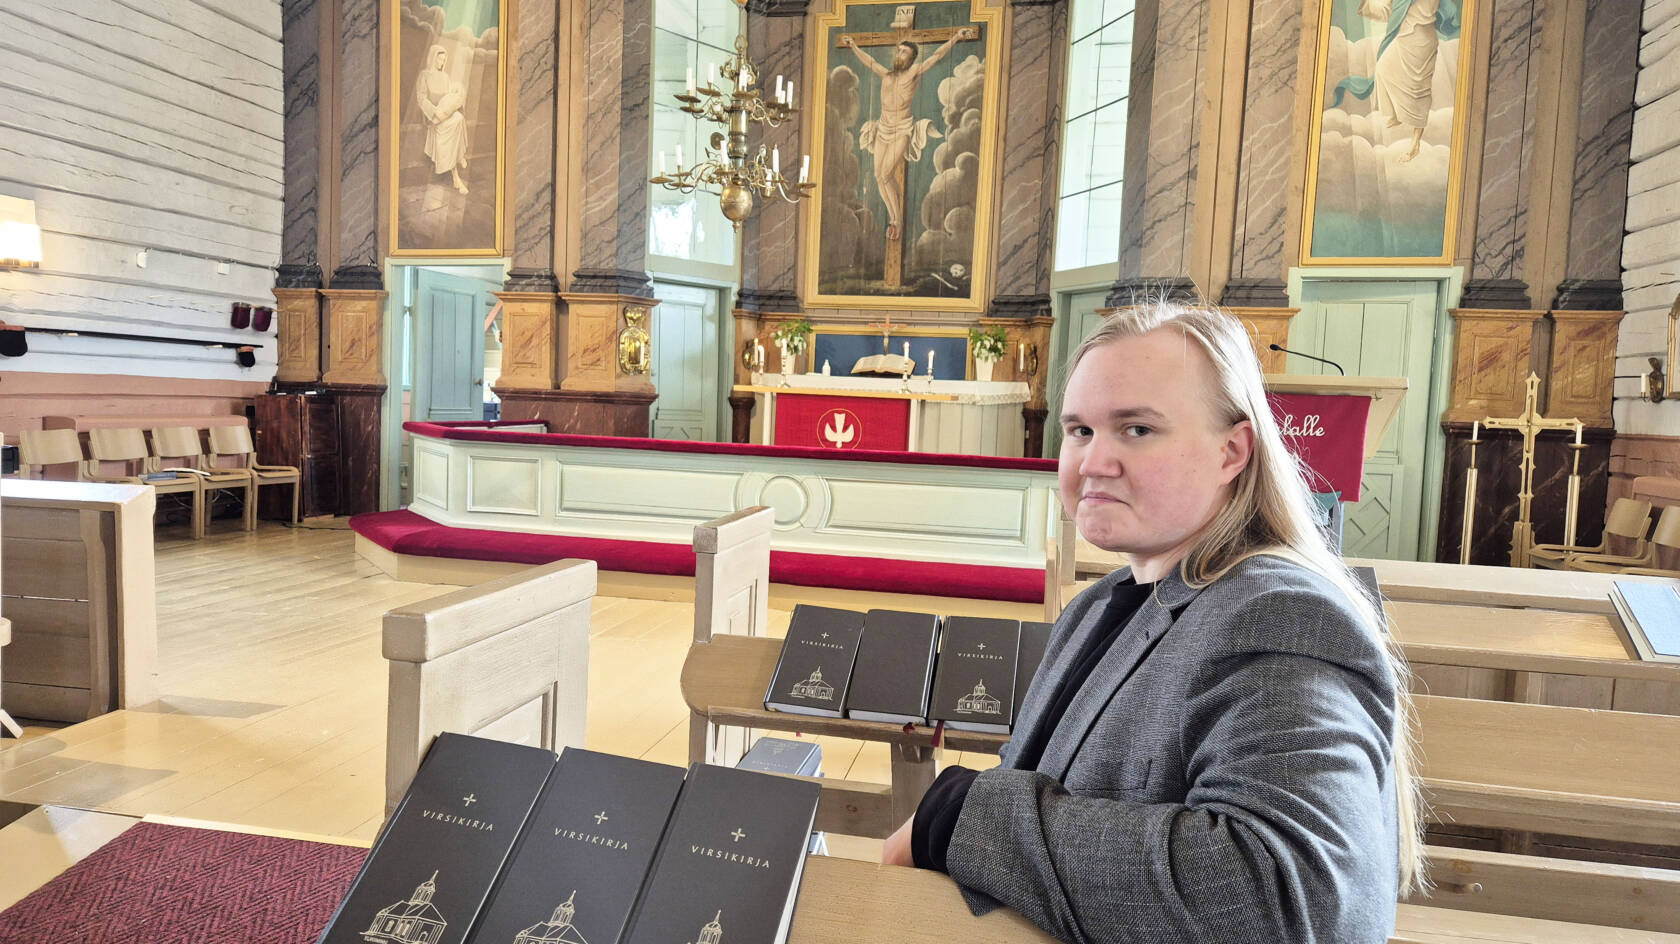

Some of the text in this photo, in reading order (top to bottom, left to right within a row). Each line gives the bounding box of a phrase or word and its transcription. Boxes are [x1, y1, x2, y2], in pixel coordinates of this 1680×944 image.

[1280, 414, 1325, 437] lalle
[801, 640, 844, 649] VIRSIKIRJA
[957, 652, 1003, 660] VIRSIKIRJA
[423, 810, 494, 832] VIRSIKIRJA
[554, 828, 629, 851] VIRSIKIRJA
[691, 845, 770, 869] VIRSIKIRJA
